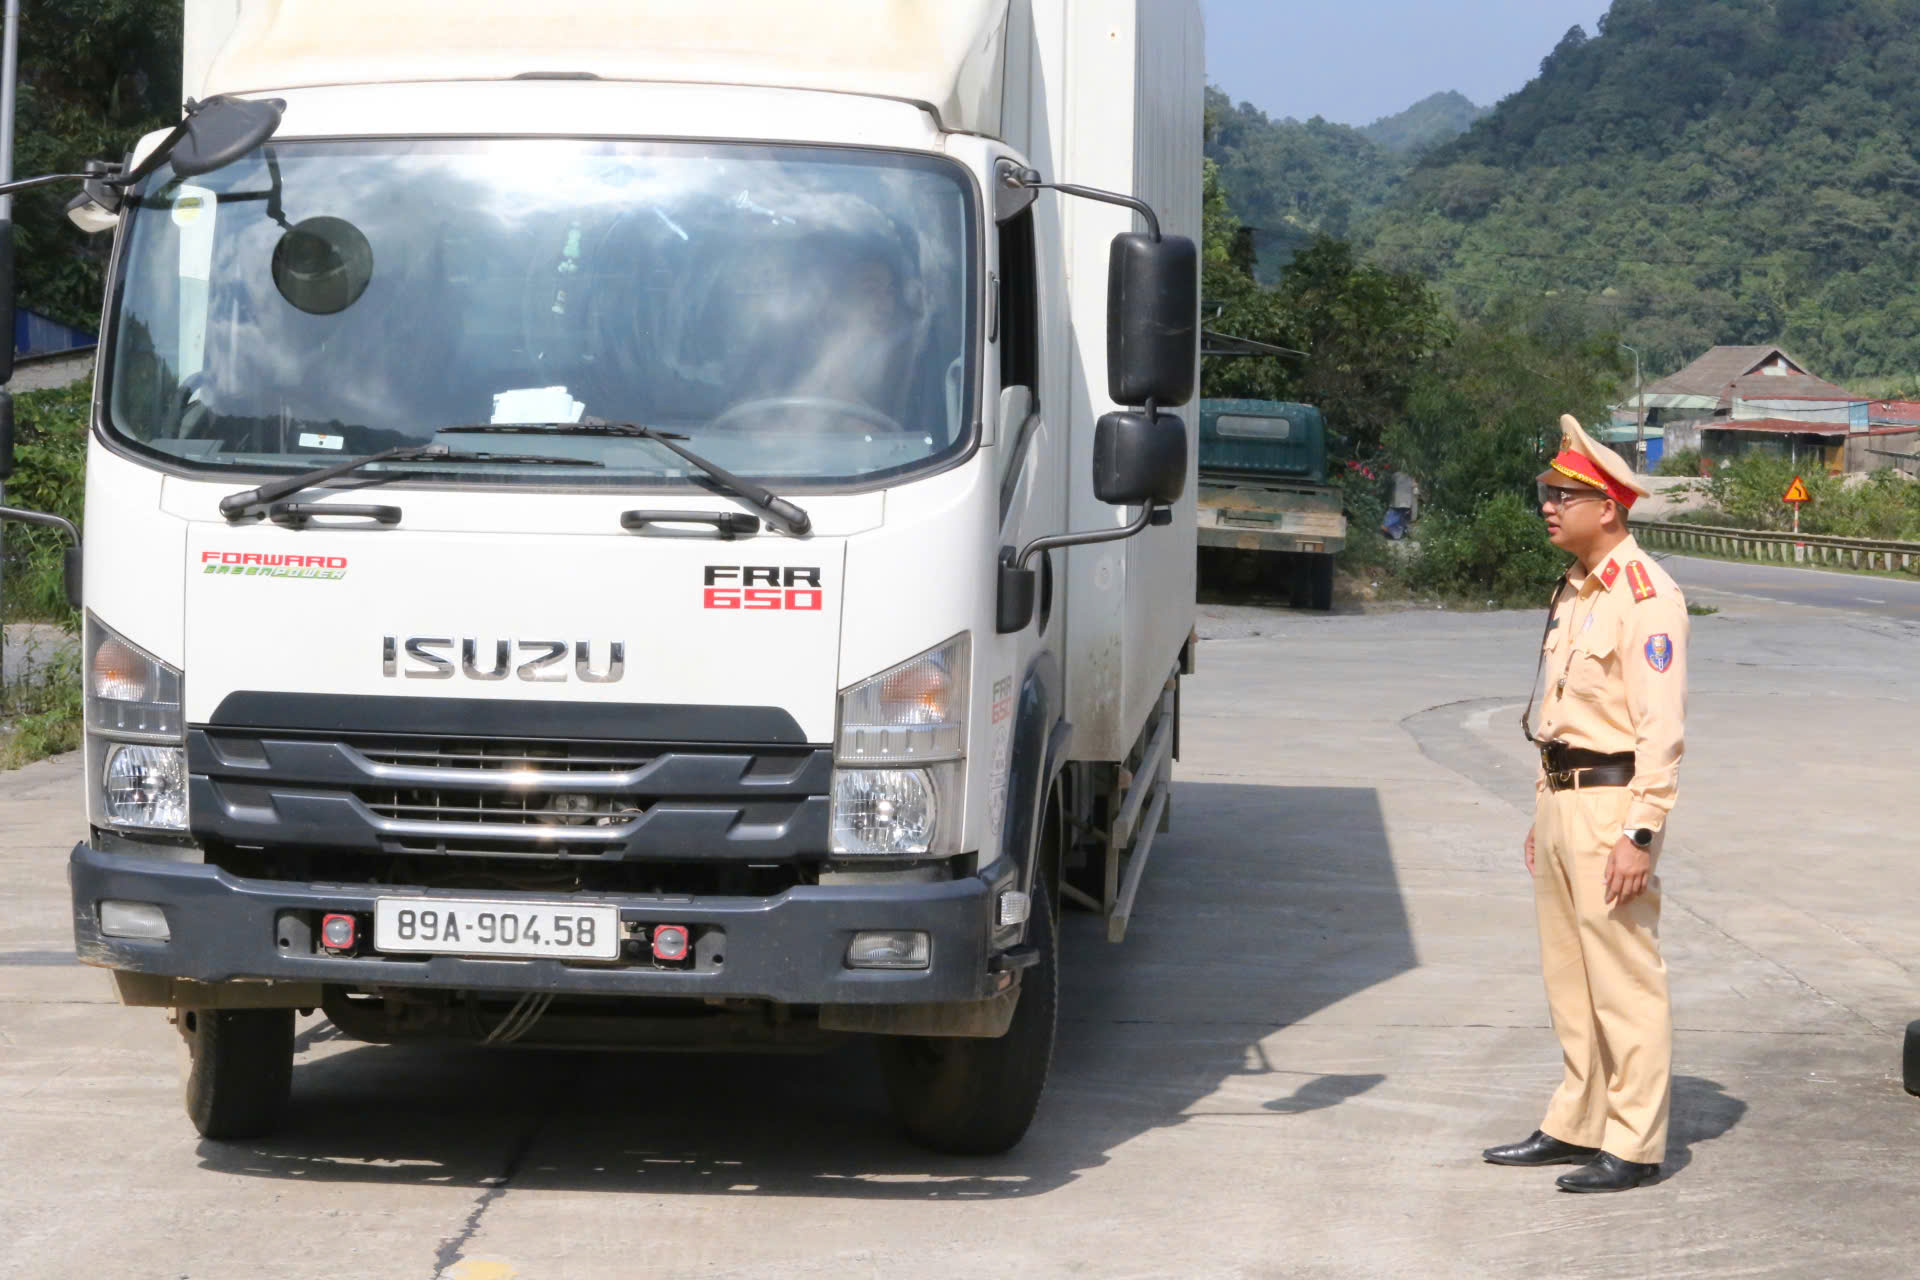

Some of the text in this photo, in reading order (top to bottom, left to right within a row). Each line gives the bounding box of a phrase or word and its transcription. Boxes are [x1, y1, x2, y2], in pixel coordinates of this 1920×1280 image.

[201, 551, 348, 569] FORWARD
[703, 565, 822, 588] FRR
[703, 588, 823, 611] 650
[382, 634, 625, 683] ISUZU
[397, 909, 597, 948] 89A-904.58
